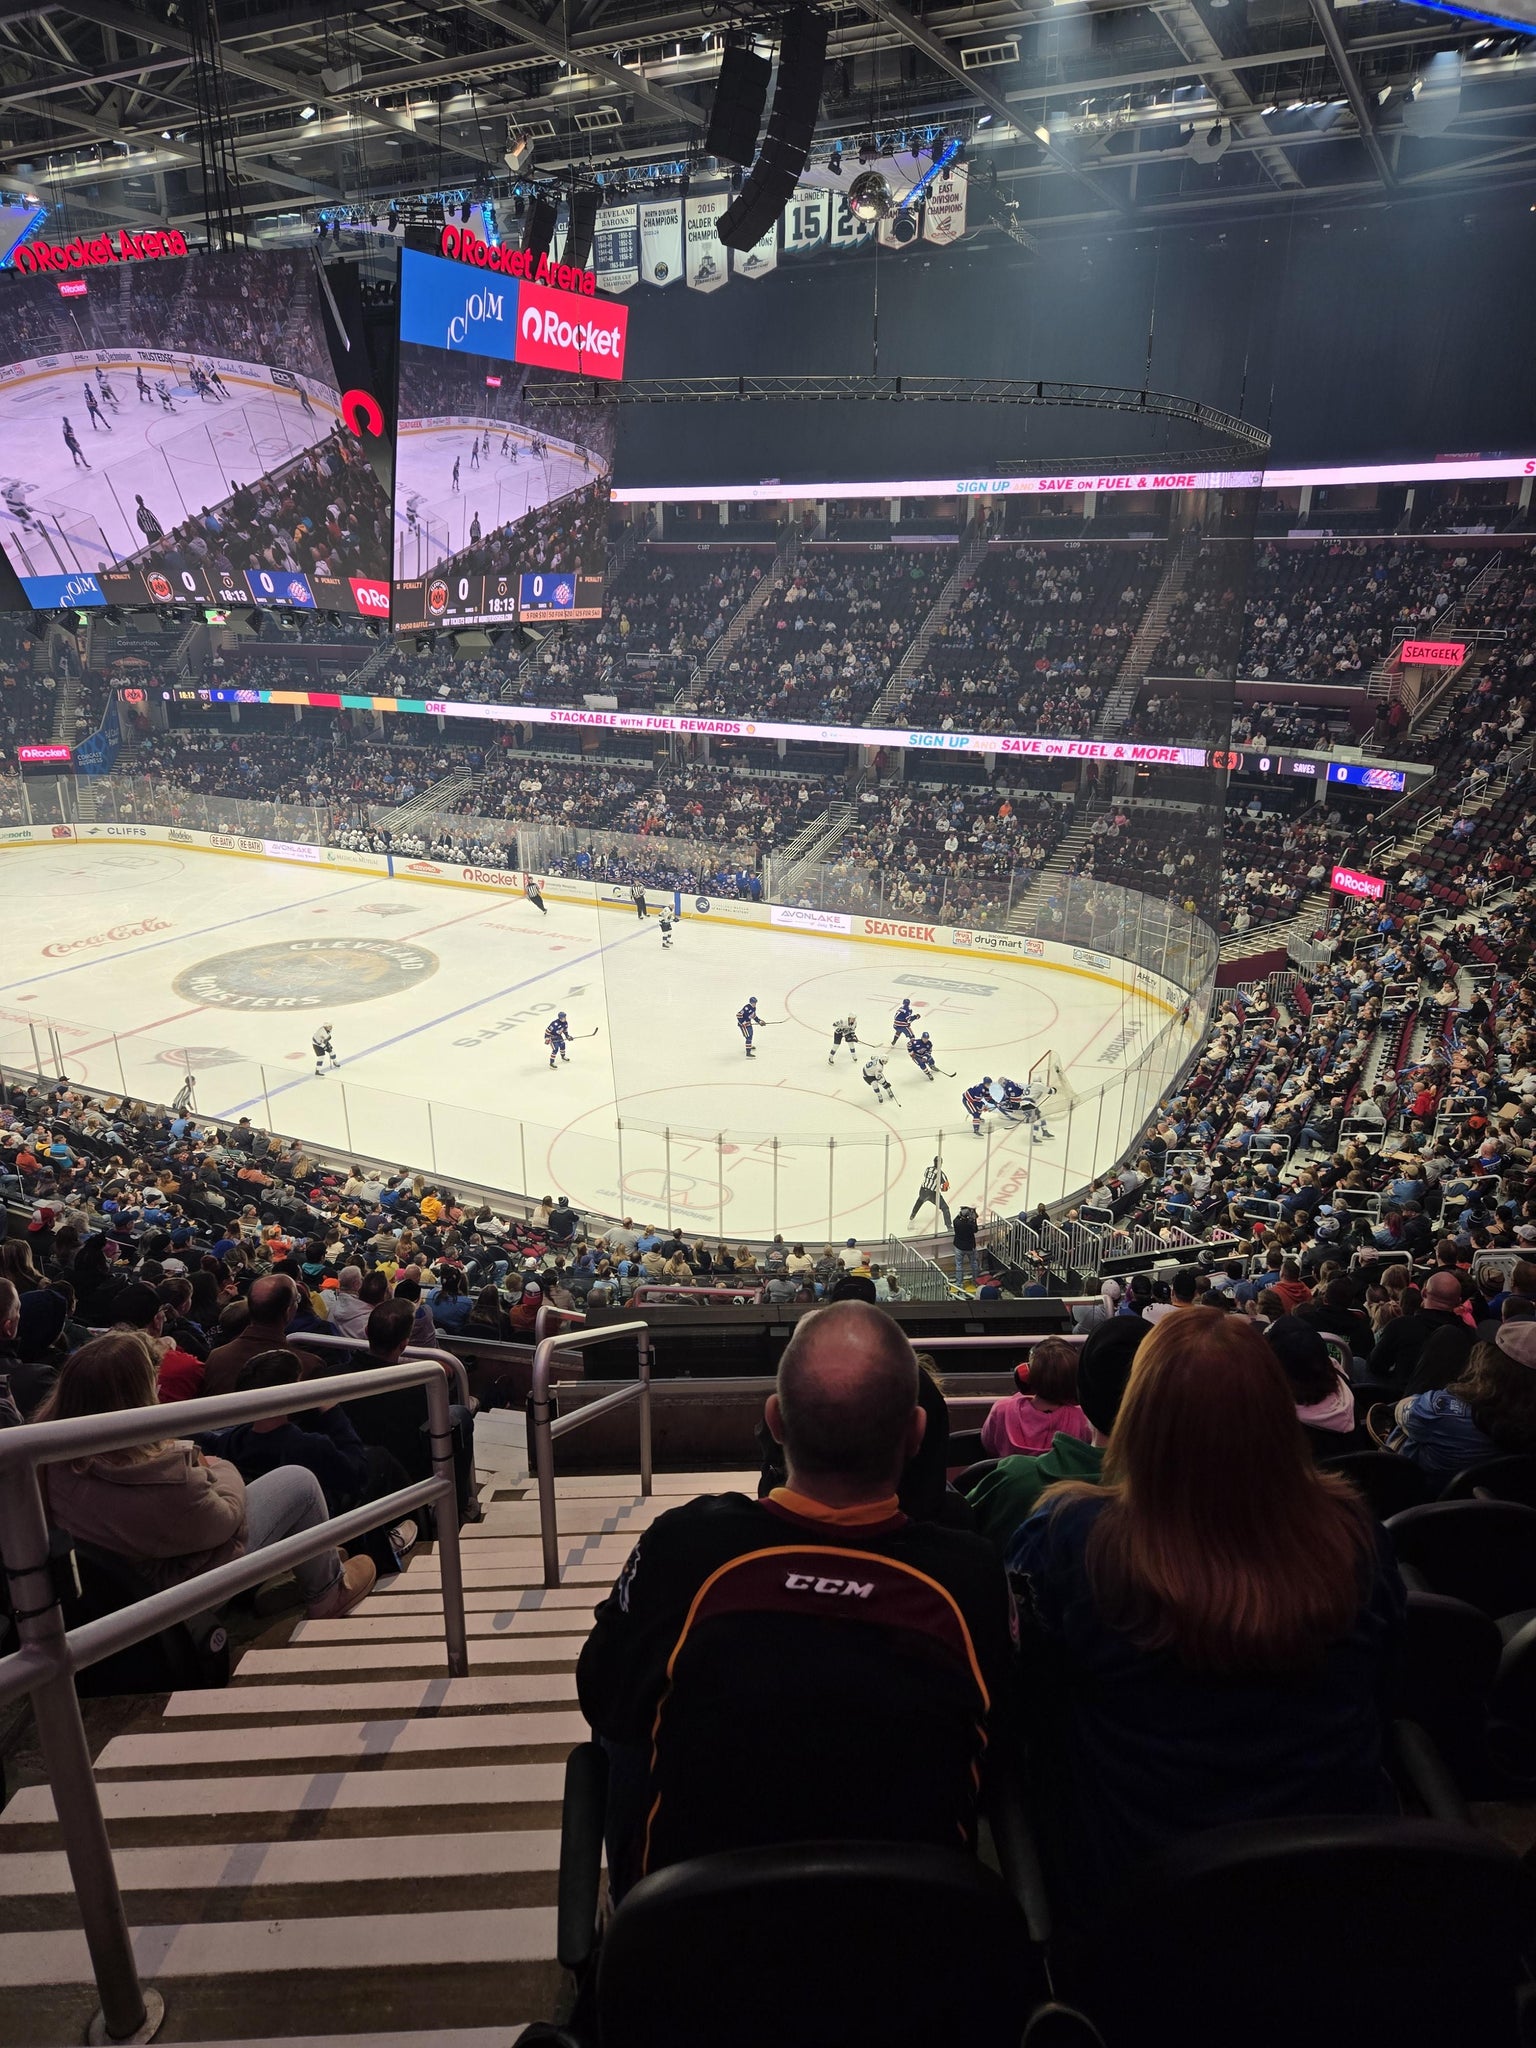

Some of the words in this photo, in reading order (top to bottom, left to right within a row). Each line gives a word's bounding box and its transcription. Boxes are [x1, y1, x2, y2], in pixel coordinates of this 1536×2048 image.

[938, 184, 953, 194] EAST
[932, 194, 960, 204] DIVISION
[658, 208, 676, 216] DIVISION
[698, 203, 716, 214] 2016
[928, 202, 963, 215] CHAMPIONS
[602, 218, 630, 227] BARONS
[644, 215, 678, 228] CHAMPIONS
[688, 218, 712, 230] CALDER
[792, 204, 820, 240] 15
[688, 230, 720, 242] CHAMPIO
[31, 232, 119, 272] Rocket
[118, 230, 188, 262] Arena
[462, 228, 534, 280] Rocket
[534, 252, 597, 296] Arena
[544, 309, 620, 358] Rocket
[956, 481, 988, 493] SIGN
[992, 480, 1010, 492] UP
[1038, 478, 1074, 490] SAVE
[1096, 476, 1132, 490] FUEL
[1137, 476, 1147, 488] &
[1152, 474, 1196, 487] MORE
[181, 572, 196, 592] 0
[260, 572, 274, 593] 0
[458, 578, 469, 600] 0
[533, 575, 543, 597] 0
[219, 590, 248, 602] 18:13
[489, 598, 515, 613] 18:13
[1405, 646, 1460, 661] SEATGEEK
[425, 703, 447, 713] ORE
[550, 711, 617, 725] STACKABLE
[620, 718, 643, 727] WITH
[646, 717, 676, 729] FUEL
[680, 720, 740, 734] REWARDS
[31, 749, 67, 758] Rocket
[909, 734, 944, 747] SIGN
[949, 736, 969, 748] UP
[1001, 739, 1040, 752] SAVE
[1068, 743, 1108, 757] FUEL
[1114, 746, 1124, 757] &
[1131, 747, 1180, 761] MORE
[1259, 758, 1270, 771] 0
[1293, 763, 1315, 775] SAVES
[1337, 767, 1348, 781] 0
[107, 827, 147, 836] CLIFFS
[475, 869, 518, 887] Rocket
[864, 919, 936, 943] SEATGEEK
[975, 936, 997, 946] drug
[999, 940, 1022, 949] mart
[1026, 940, 1041, 949] drug
[290, 941, 425, 970] CLEVELAND
[1027, 947, 1043, 955] mart
[191, 975, 322, 1007] MONSTERS
[452, 1002, 557, 1048] CLIFFS
[784, 1572, 875, 1599] CCM
